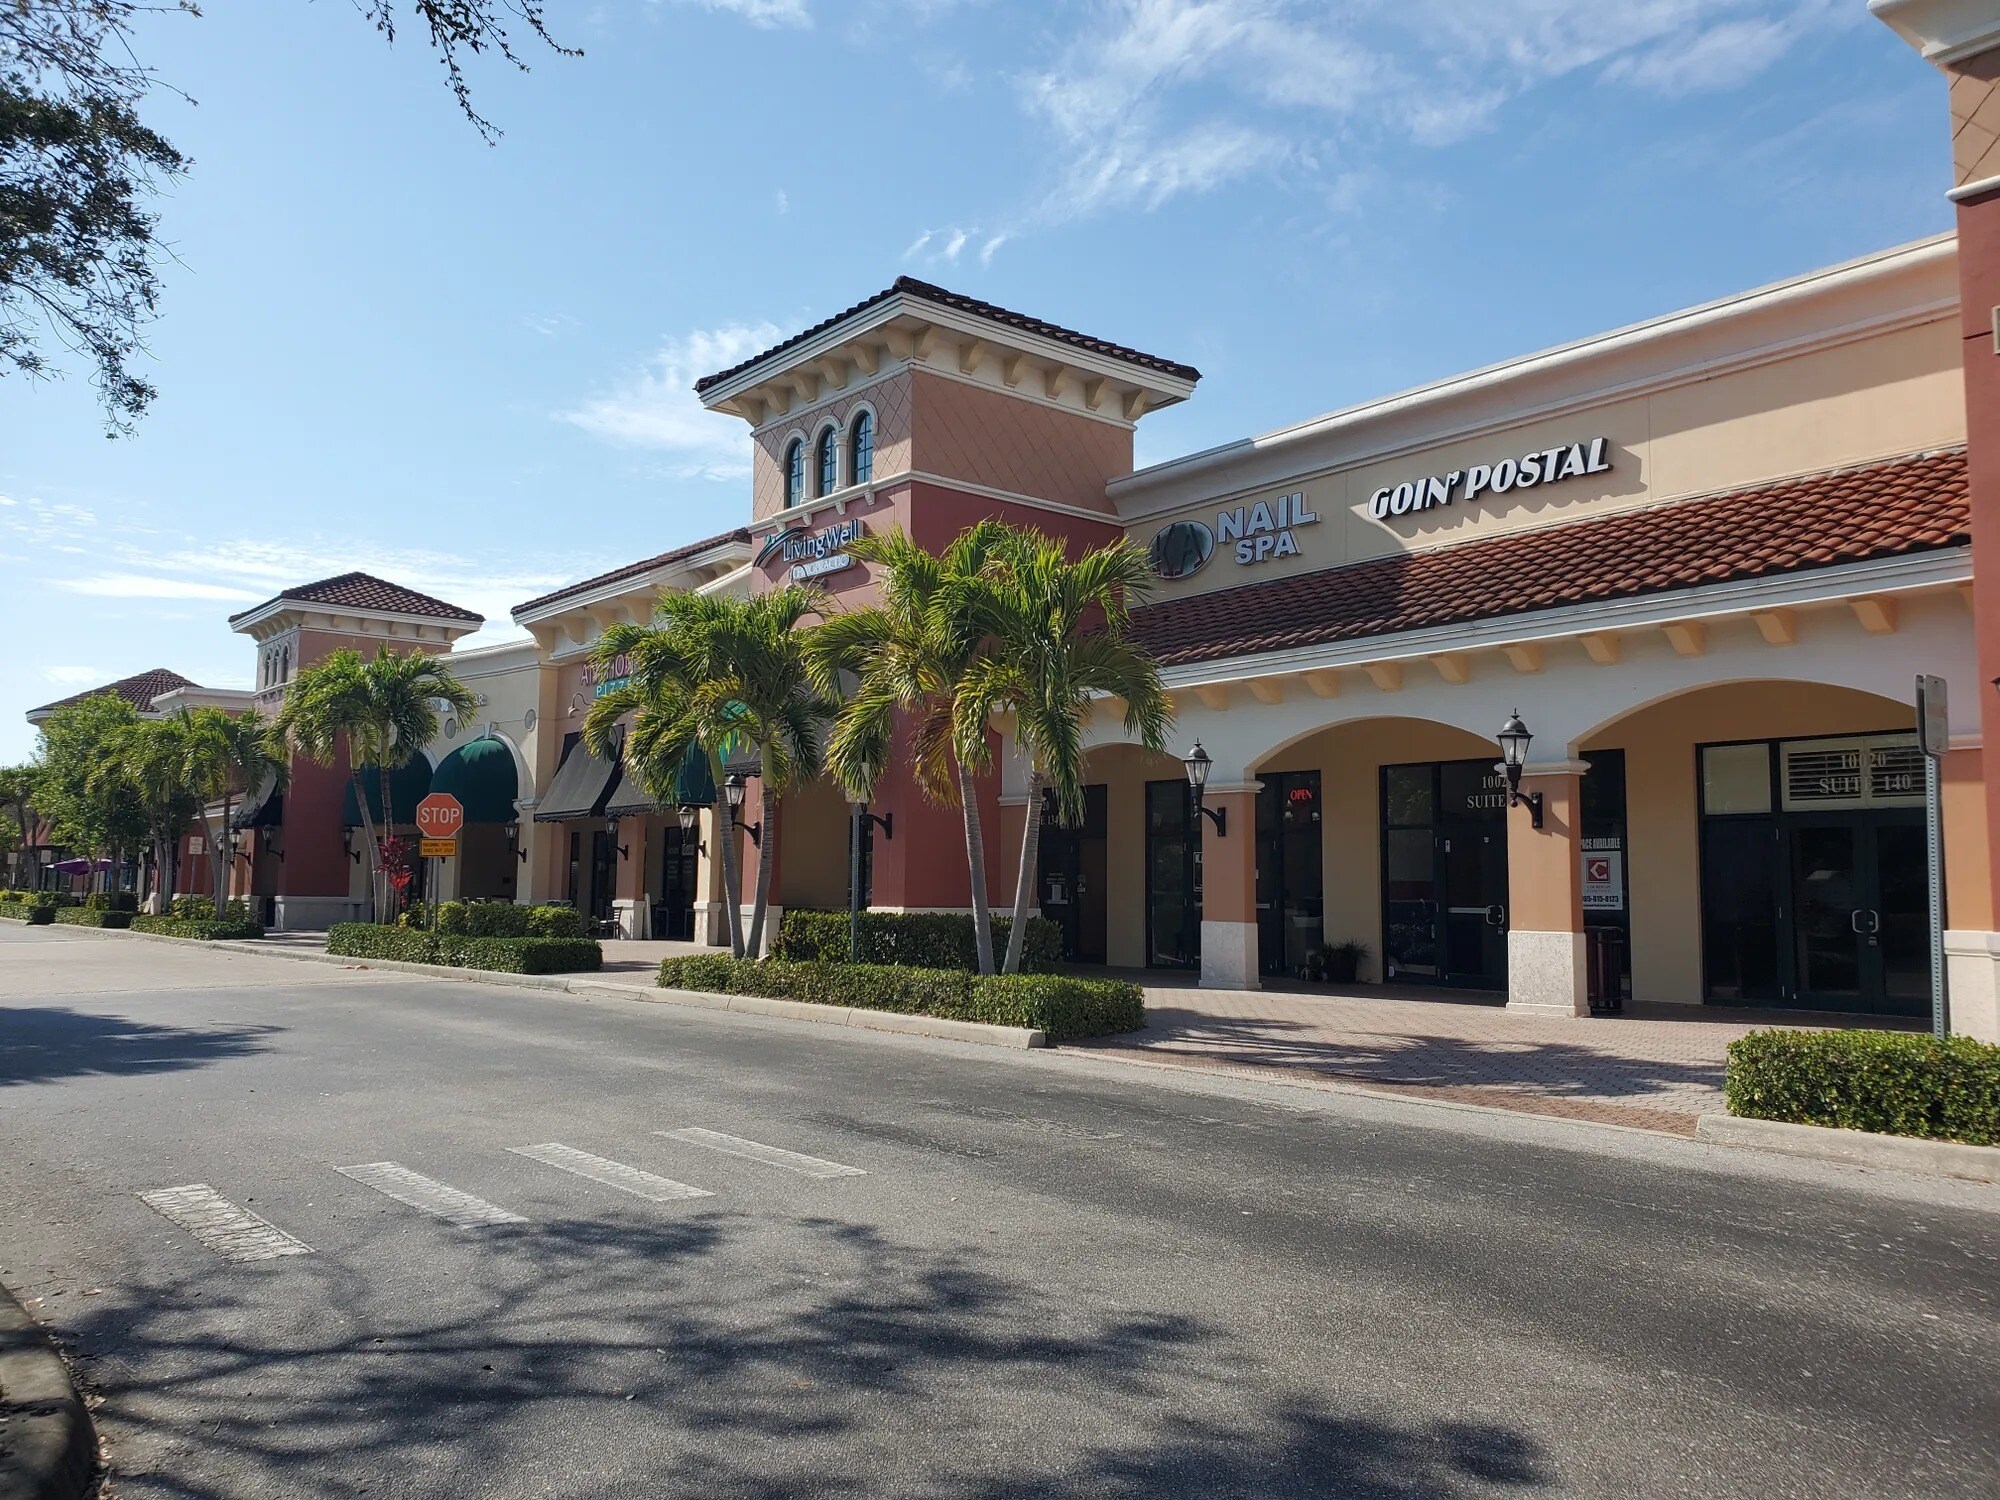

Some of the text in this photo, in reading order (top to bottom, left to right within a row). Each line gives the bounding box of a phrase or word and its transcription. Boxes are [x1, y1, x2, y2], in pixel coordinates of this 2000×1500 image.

[1368, 437, 1612, 519] GOIN' POSTAL
[1217, 492, 1318, 544] NAIL
[1234, 530, 1299, 565] SPA
[1841, 752, 1886, 769] 10020
[1481, 775, 1507, 789] 1002
[1820, 774, 1911, 793] SUITE 140
[1290, 789, 1312, 800] OPEN
[1467, 794, 1506, 809] SUITE
[420, 807, 460, 824] STOP
[1593, 837, 1621, 849] AVAILABLE
